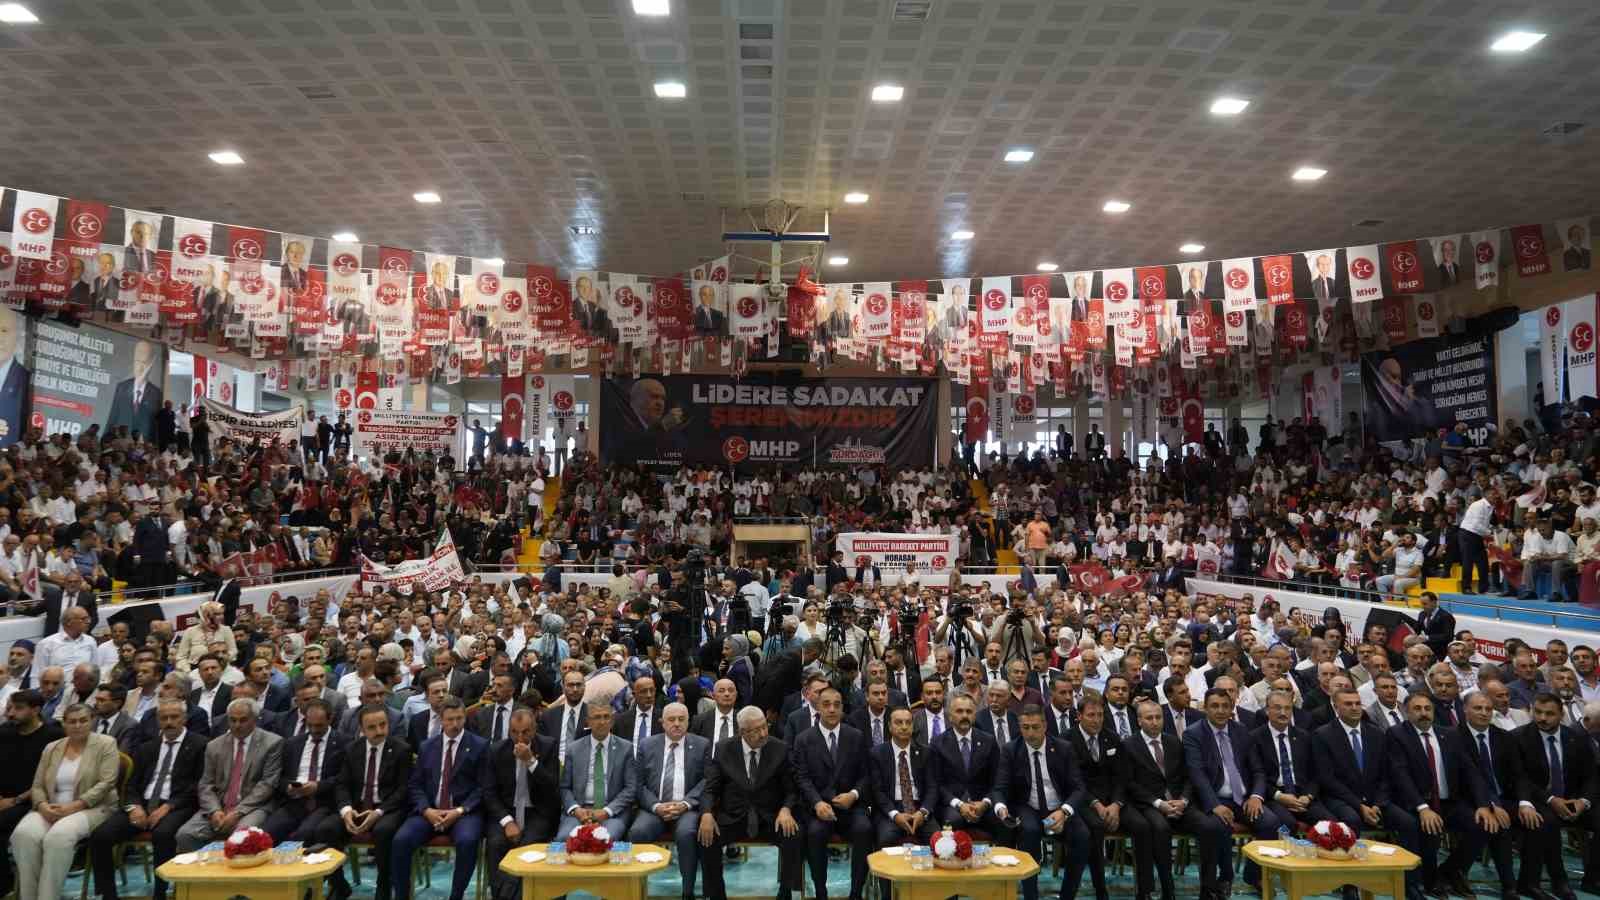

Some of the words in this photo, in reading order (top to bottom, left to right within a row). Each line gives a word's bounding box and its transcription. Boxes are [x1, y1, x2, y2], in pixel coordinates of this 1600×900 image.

[18, 242, 46, 254] MHP
[70, 246, 97, 256] MHP
[177, 268, 203, 277] MHP
[1522, 263, 1547, 275] MHP
[1398, 279, 1419, 290] MHP
[332, 286, 356, 294] MHP
[1355, 287, 1378, 298] MHP
[1271, 293, 1291, 303] MHP
[475, 303, 498, 313] MHP
[1144, 305, 1163, 314] MHP
[130, 311, 153, 320] MHP
[258, 323, 281, 332] MHP
[986, 318, 1008, 328] MHP
[1569, 352, 1595, 366] MHP
[692, 383, 788, 406] LİDERE
[793, 385, 925, 406] SADAKAT
[533, 393, 541, 436] ERZURUM
[47, 418, 81, 437] MHP
[239, 416, 298, 430] BELEDİYESİ
[1468, 427, 1488, 446] HP
[362, 440, 400, 448] SONSUZ
[750, 440, 800, 456] MHP
[890, 541, 918, 551] HAREKET
[920, 541, 947, 551] PARTİSİ
[884, 554, 916, 562] HORASAN
